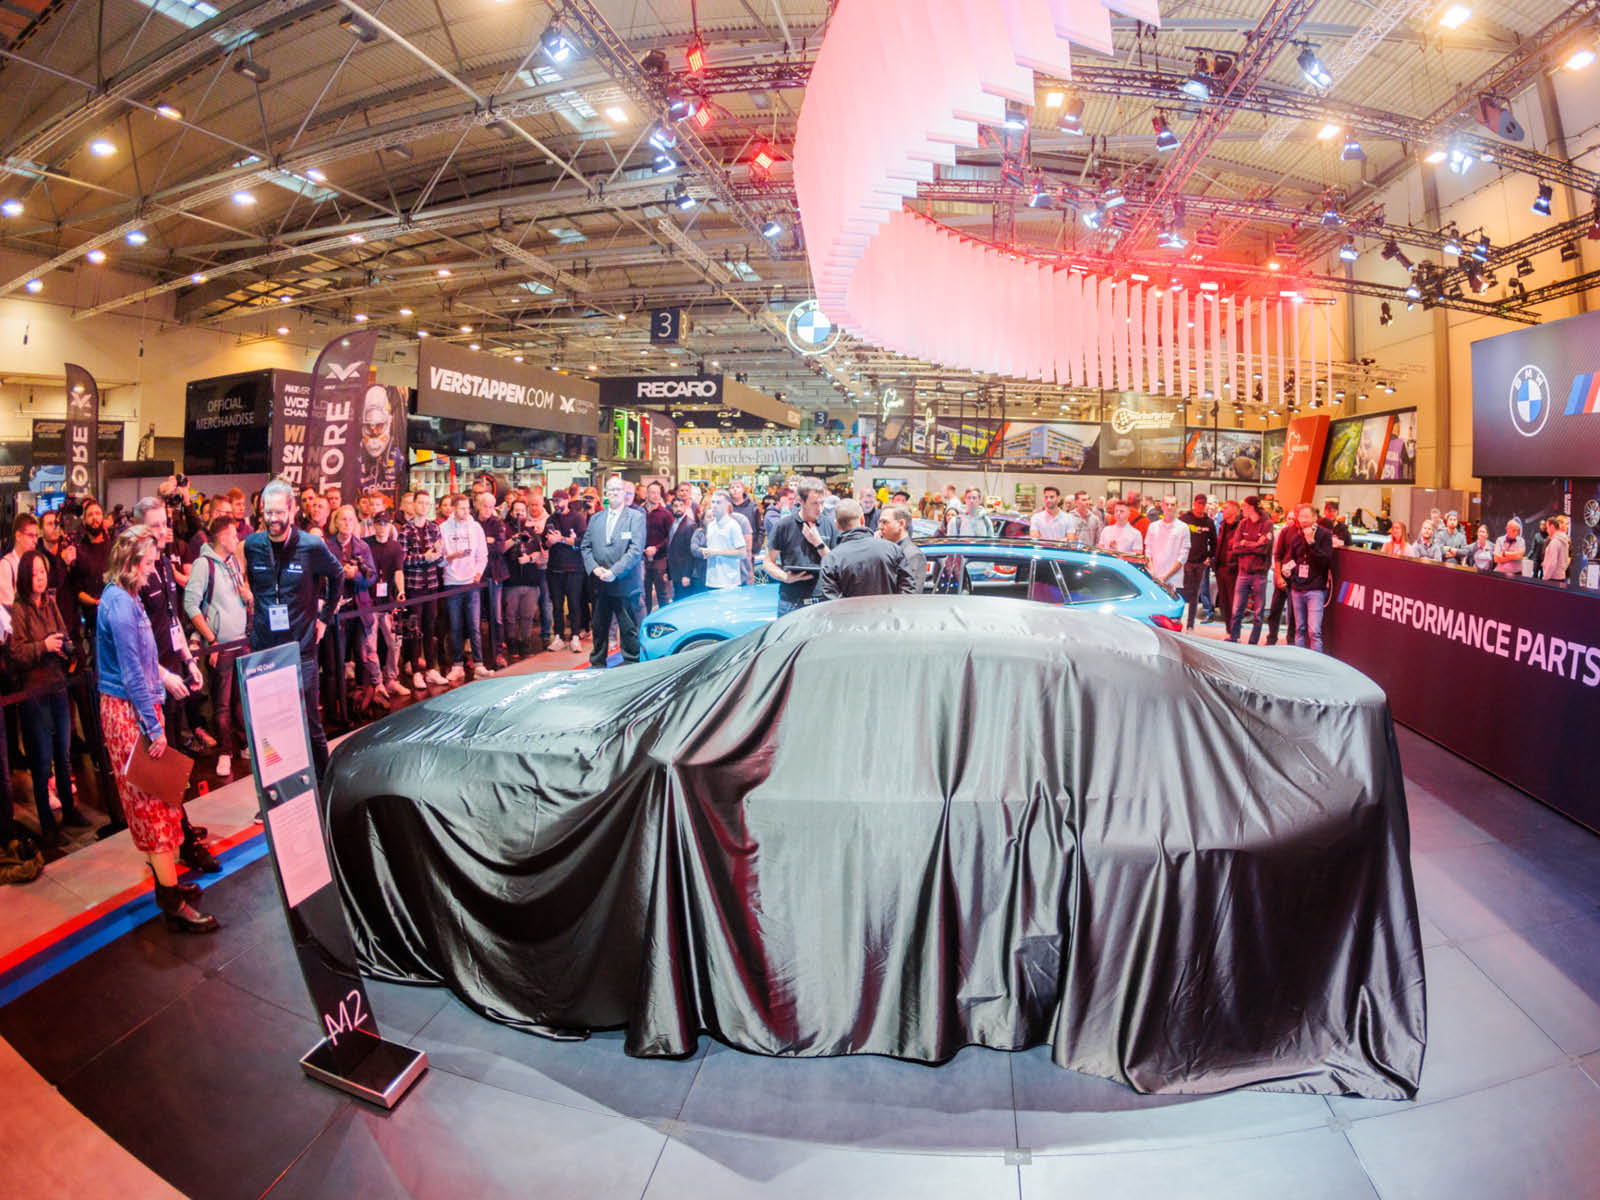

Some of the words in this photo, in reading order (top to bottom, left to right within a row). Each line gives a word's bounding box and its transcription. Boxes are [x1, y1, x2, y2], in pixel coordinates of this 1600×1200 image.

[657, 312, 673, 338] 3
[430, 365, 555, 410] VERSTAPPEN.COM
[636, 380, 717, 399] RECARO
[207, 396, 243, 413] OFFICIAL
[284, 396, 309, 408] WOR
[195, 411, 255, 431] MERCHANDISE
[284, 423, 305, 443] WI
[282, 445, 305, 464] SK
[319, 400, 351, 496] TORE
[1371, 588, 1512, 659] PERFORMANCE
[1514, 626, 1600, 688] PARTS
[323, 988, 369, 1047] M2
